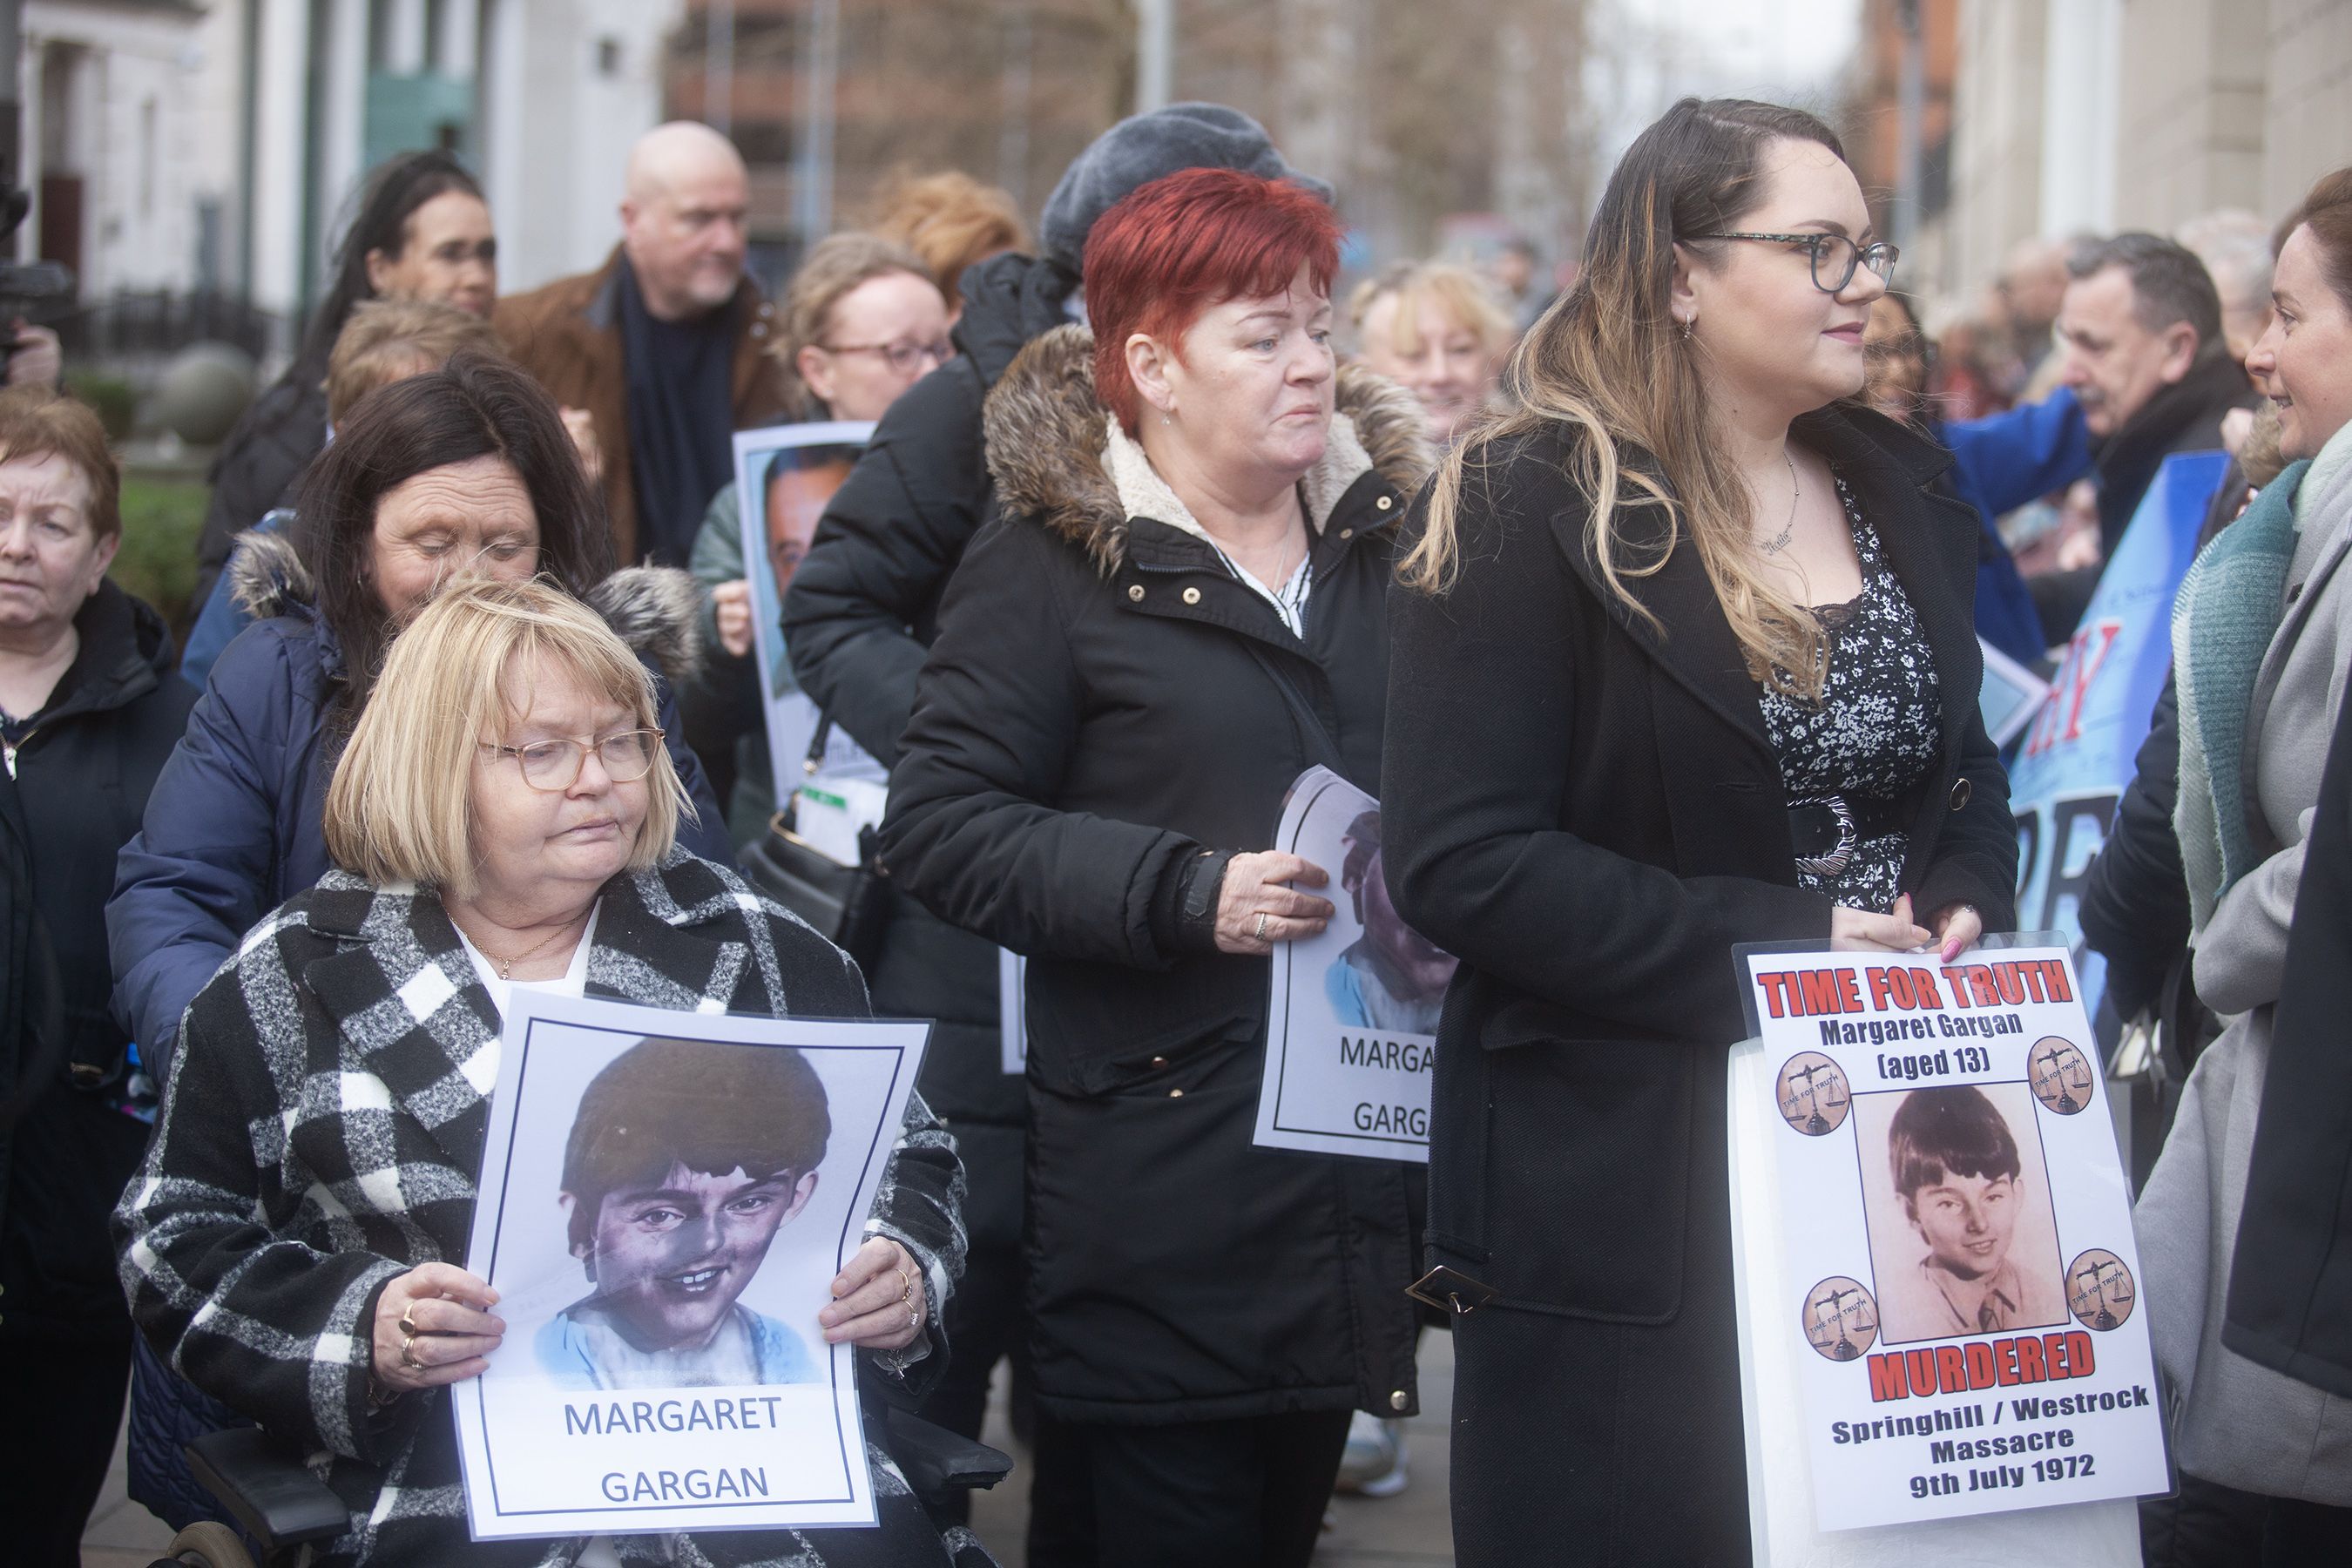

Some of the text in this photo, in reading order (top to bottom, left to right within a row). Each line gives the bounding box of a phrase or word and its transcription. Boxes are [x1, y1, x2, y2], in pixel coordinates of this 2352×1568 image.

[1757, 959, 2074, 1018] TIME FOR TRUTH
[1819, 1010, 2024, 1046] Margaret Gargan
[1877, 1046, 1991, 1080] (aged 13)
[2035, 1058, 2081, 1088] TIME FOR TRUTH
[1782, 1074, 1839, 1108] TIME FOR TRUTH
[1354, 1102, 1430, 1137] GARG
[2072, 1271, 2124, 1304] TIME FOR TRUTH
[1809, 1298, 1867, 1334] TIME FOR TRUTH
[1866, 1330, 2095, 1402] MURDERED
[564, 1396, 782, 1436] MARGARET
[1831, 1404, 1984, 1444] Springhill
[2011, 1384, 2150, 1422] Westrock
[1930, 1427, 2074, 1464] Massacre
[601, 1467, 769, 1503] GARGAN
[1909, 1454, 2096, 1499] 9th July 1972
